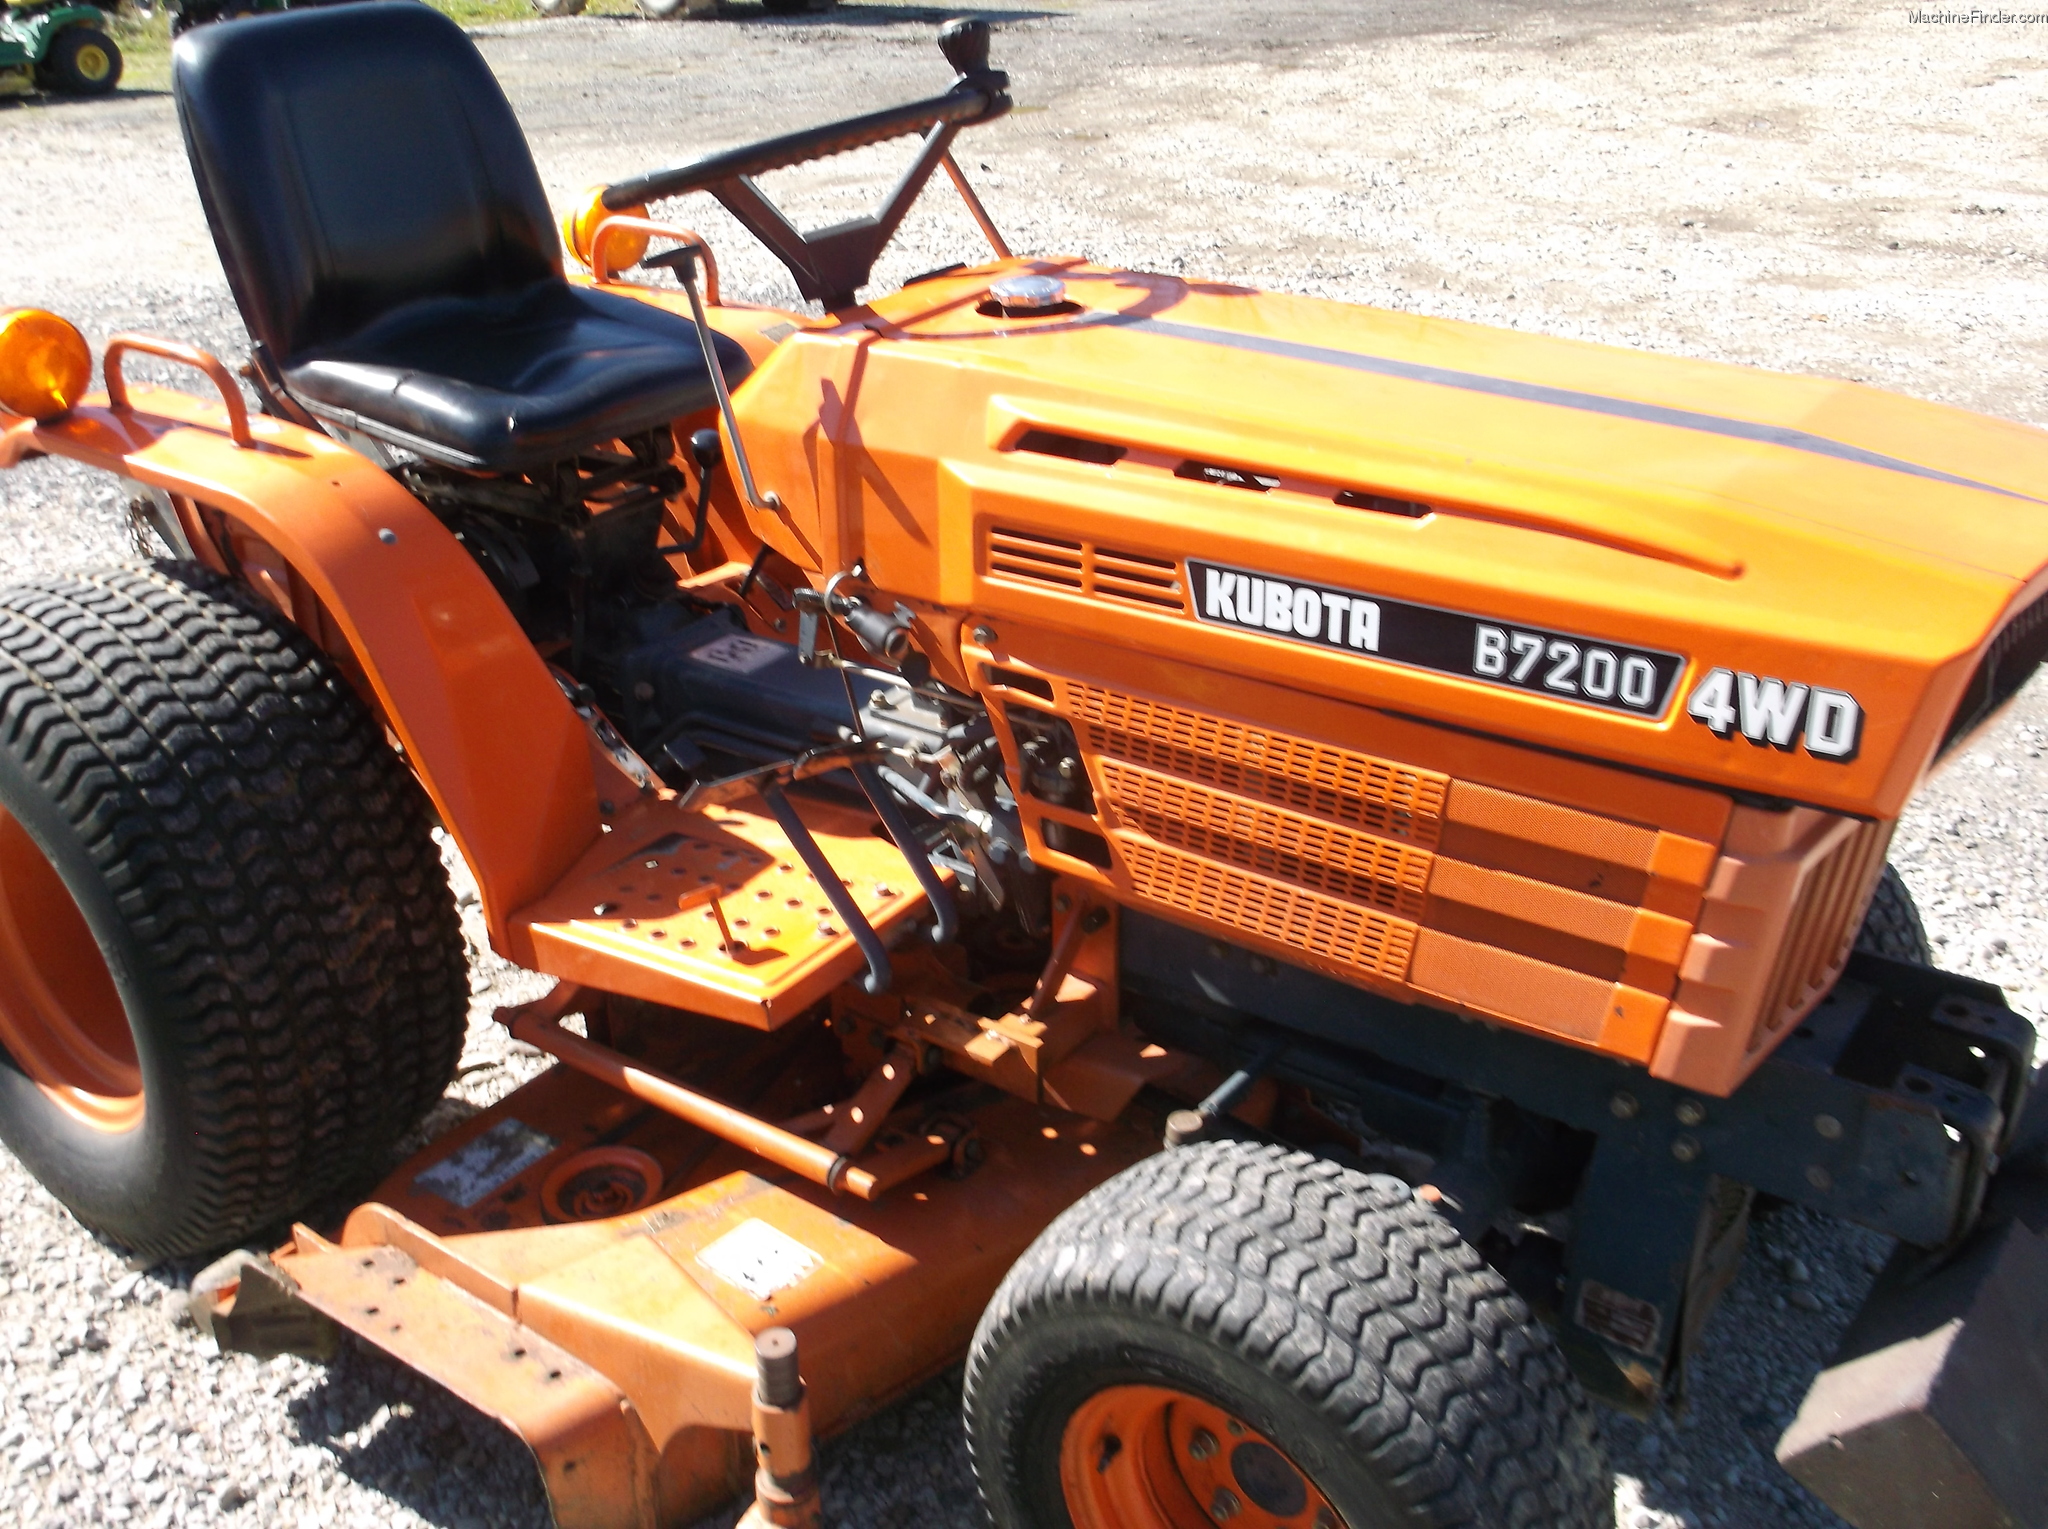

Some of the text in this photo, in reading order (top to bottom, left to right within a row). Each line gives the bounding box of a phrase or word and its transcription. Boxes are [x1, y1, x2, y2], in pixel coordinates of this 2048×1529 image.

[1205, 568, 1657, 708] KUBOTA B7200
[1687, 667, 1863, 758] 4WD
